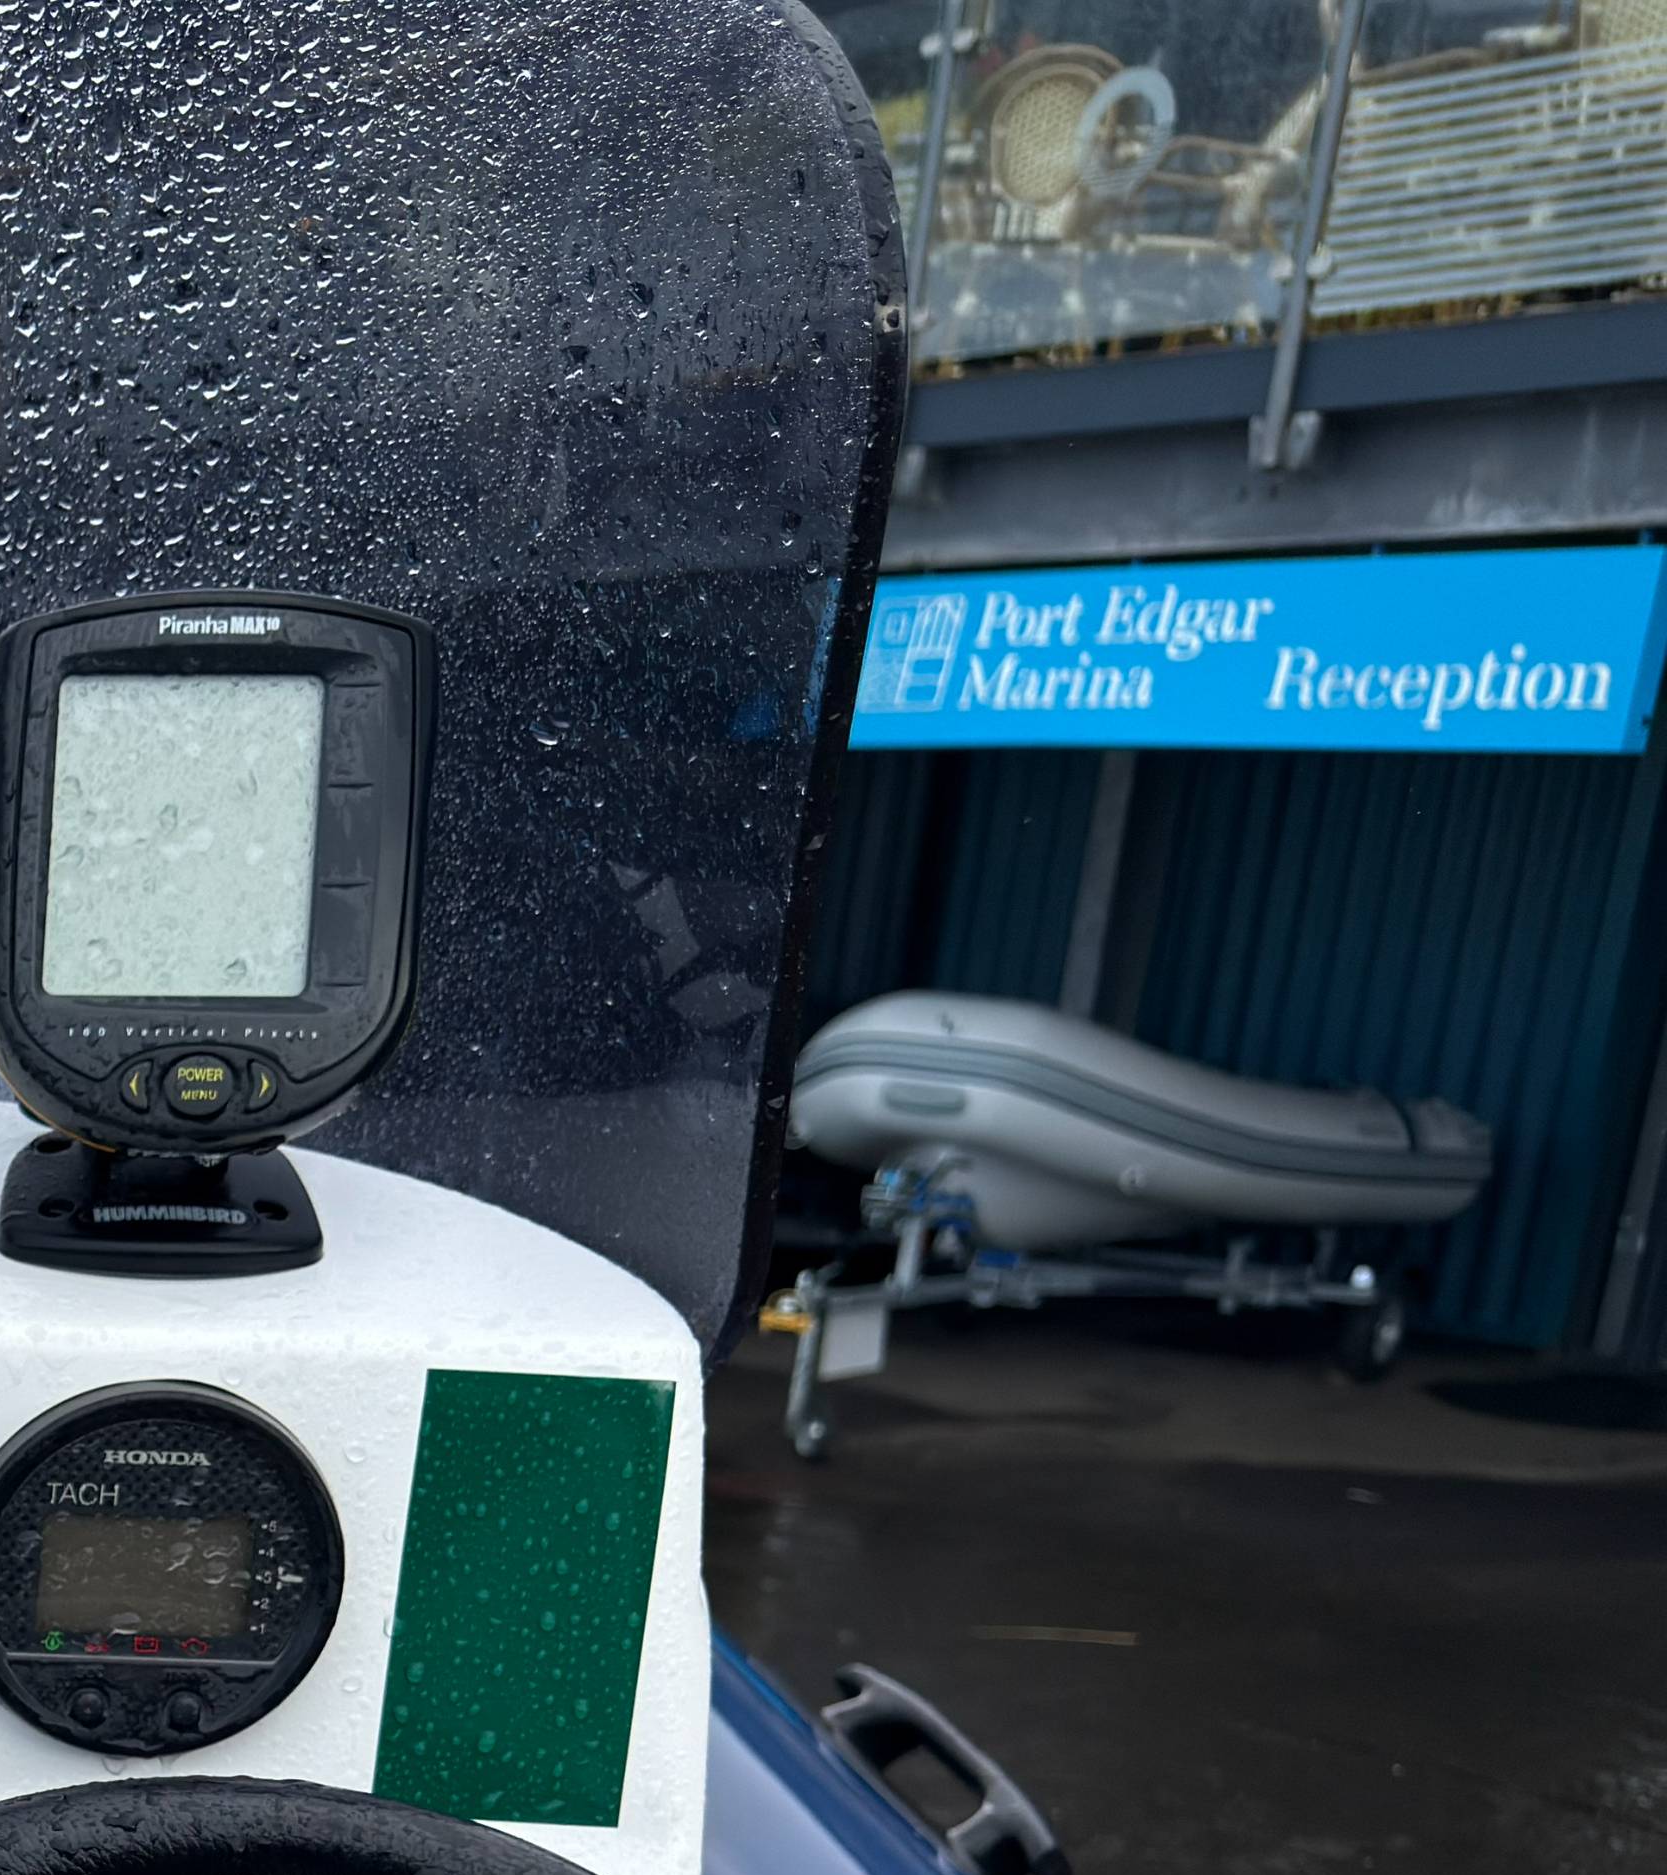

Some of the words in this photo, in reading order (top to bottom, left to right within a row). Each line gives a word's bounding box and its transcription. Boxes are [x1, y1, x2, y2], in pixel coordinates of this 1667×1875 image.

[975, 591, 1082, 649] Port
[1094, 583, 1275, 662] Edgar
[958, 651, 1154, 711] Marina
[1265, 644, 1613, 731] Reception
[69, 1026, 107, 1039] 160
[126, 1026, 227, 1039] Vertical
[244, 1027, 320, 1041] Pixels
[177, 1066, 224, 1082] POWER
[181, 1088, 218, 1101] MENU
[93, 1205, 248, 1225] HUMMINBIRD
[103, 1450, 211, 1467] HONDA
[47, 1482, 120, 1506] TACH
